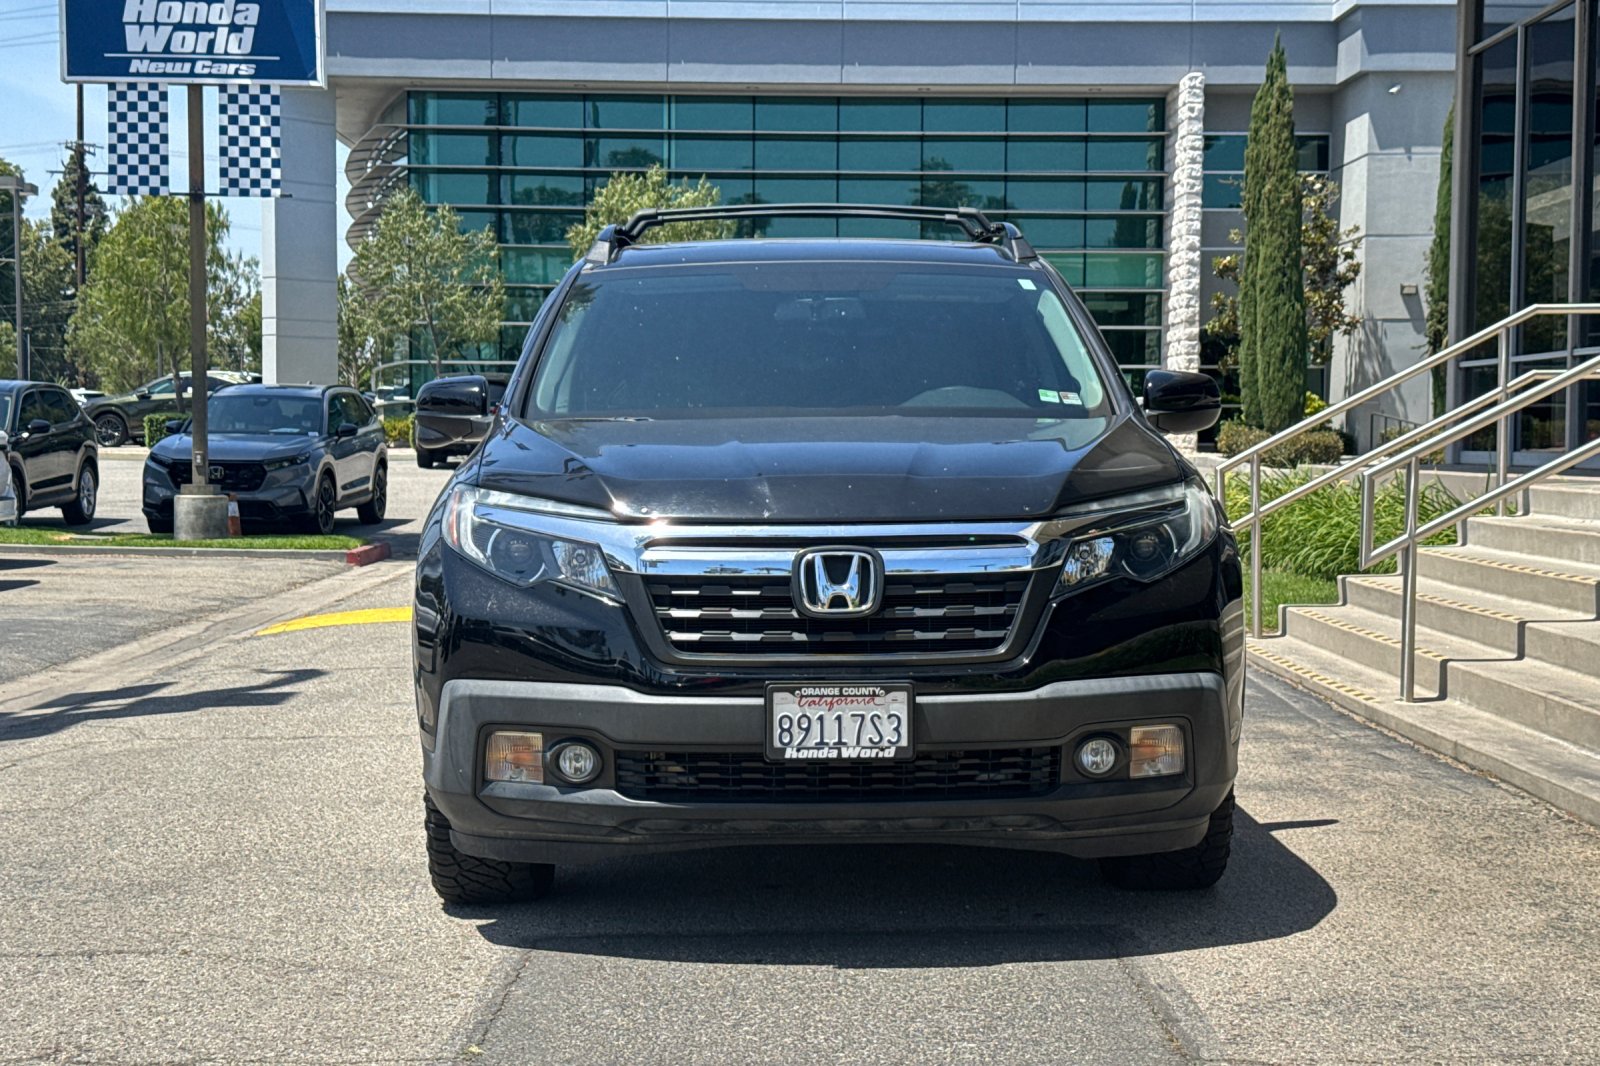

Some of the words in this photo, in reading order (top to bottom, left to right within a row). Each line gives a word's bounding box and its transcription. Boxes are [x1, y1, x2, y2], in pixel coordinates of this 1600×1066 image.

[122, 0, 260, 25] Honda
[124, 24, 255, 54] World
[128, 58, 192, 74] New
[193, 60, 257, 75] Cars
[801, 687, 840, 696] ORANGE
[842, 687, 880, 696] COUNTY
[798, 696, 885, 712] California
[777, 712, 902, 746] 89117S3
[784, 747, 839, 759] Honda
